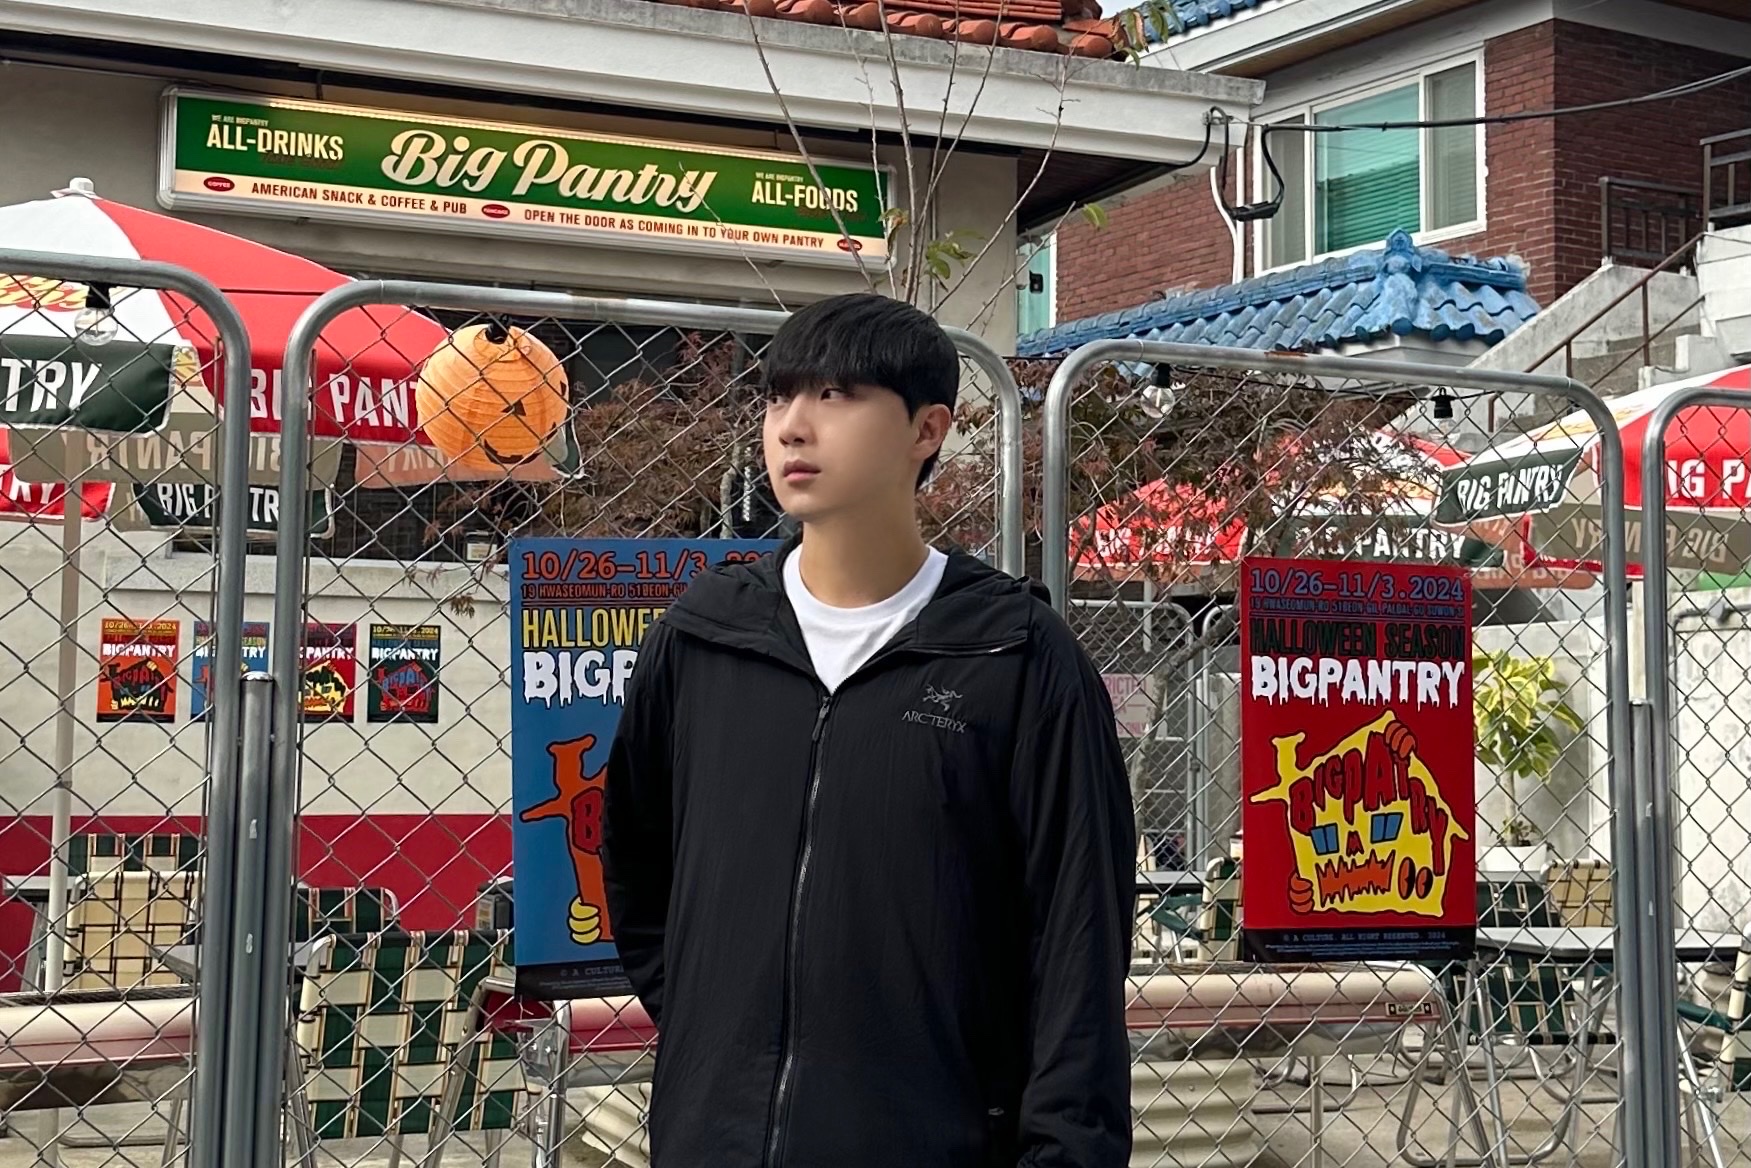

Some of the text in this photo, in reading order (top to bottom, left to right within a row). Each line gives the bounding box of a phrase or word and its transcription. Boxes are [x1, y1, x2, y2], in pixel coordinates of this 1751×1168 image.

[206, 123, 344, 161] ALL-DRINKS
[381, 129, 718, 213] Big Pantry
[251, 182, 467, 214] AMERICAN SNACK & COFFEE & PUB
[751, 180, 858, 213] ALL-FOODS
[524, 209, 555, 222] OPEN
[560, 212, 580, 225] THE
[584, 214, 615, 228] DOOR
[619, 216, 634, 230] AS
[638, 219, 683, 236] COMING
[687, 224, 699, 237] IN
[703, 225, 717, 239] TO
[720, 227, 749, 241] YOUR
[753, 230, 778, 244] OWN
[782, 233, 824, 249] PANTRY
[1457, 464, 1563, 515] BIG PANTRY
[523, 583, 536, 599] 19
[1251, 567, 1464, 601] 10/26-11/3.2024
[1251, 618, 1465, 660] HALLOWEEN SEASON
[1251, 655, 1465, 712] BIGPANTRY
